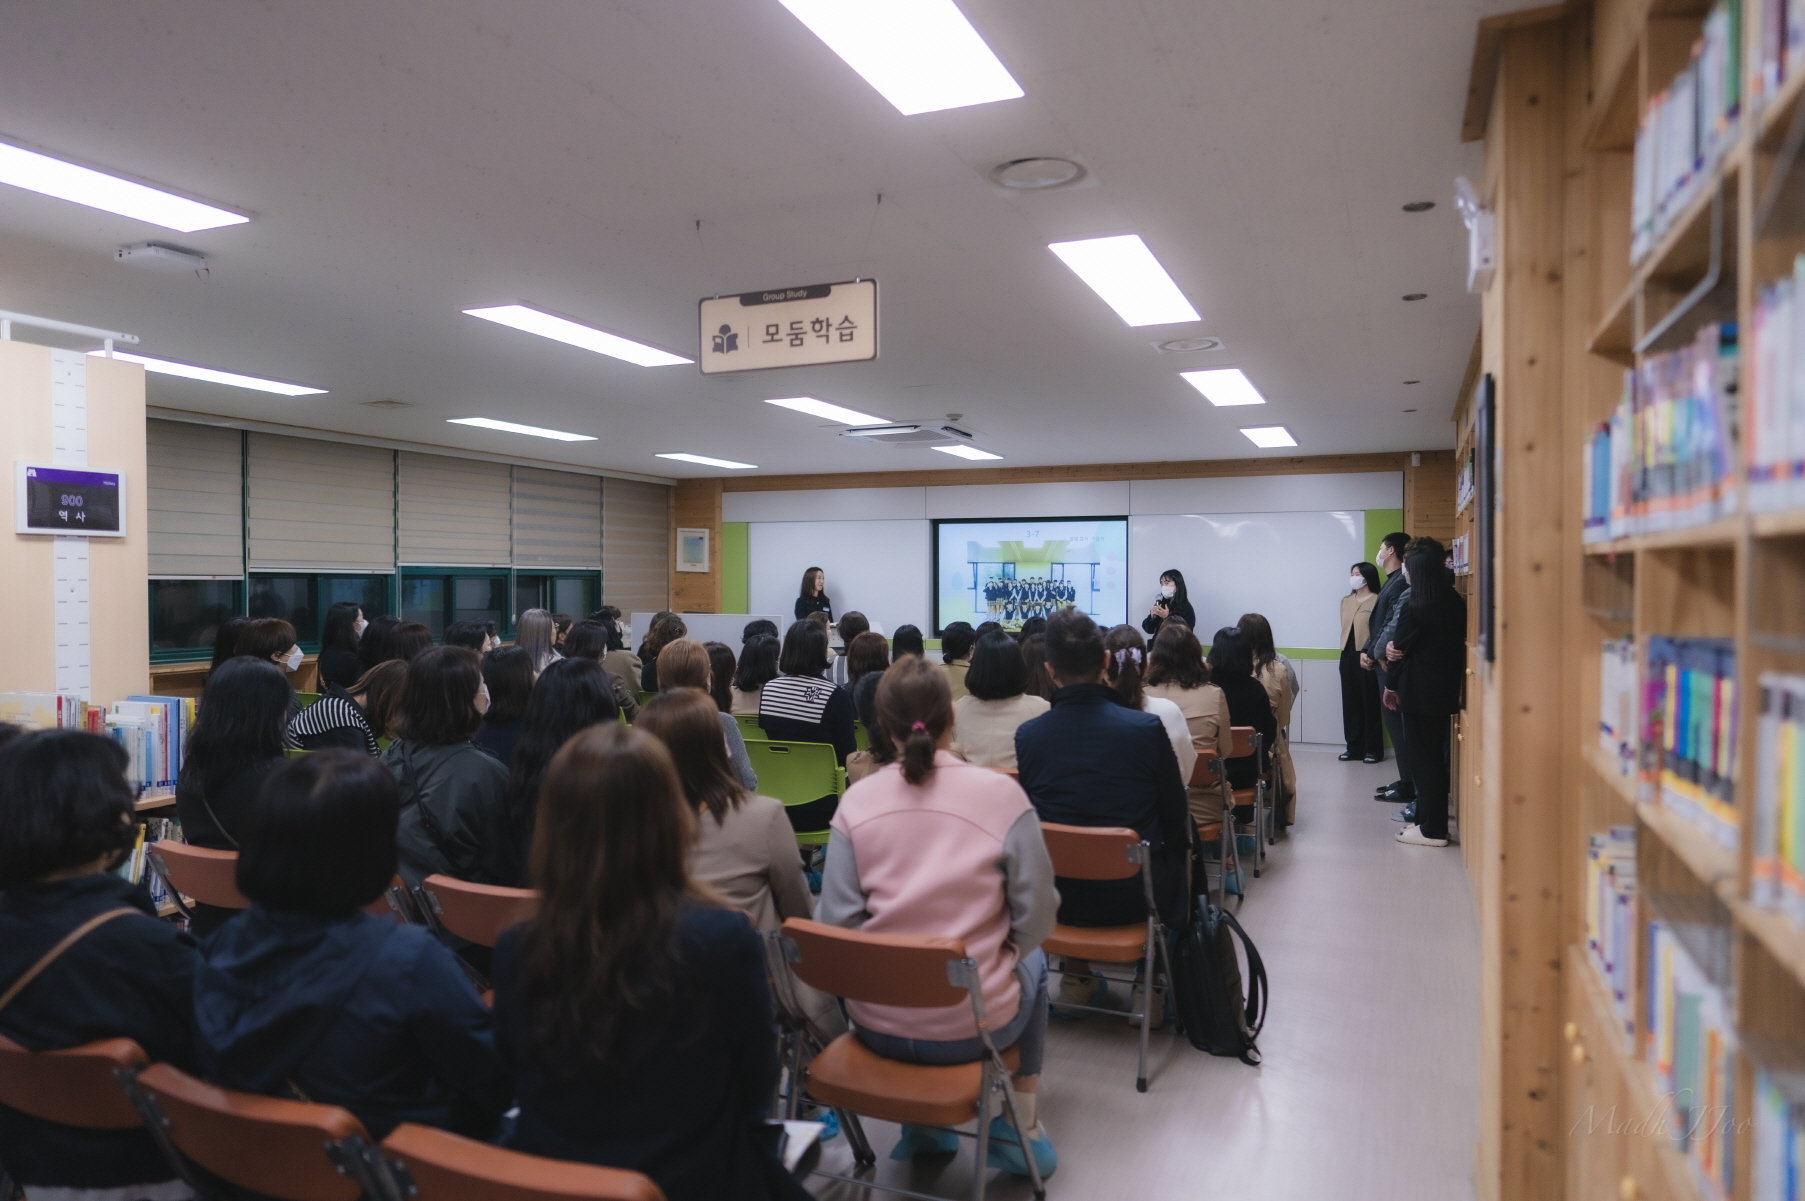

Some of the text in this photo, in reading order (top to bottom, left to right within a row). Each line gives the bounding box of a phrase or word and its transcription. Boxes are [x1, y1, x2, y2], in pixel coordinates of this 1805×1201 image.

[762, 289, 808, 301] Group Study
[762, 315, 858, 347] 모둠학습
[61, 494, 83, 506] 900
[1026, 530, 1040, 538] 3-7
